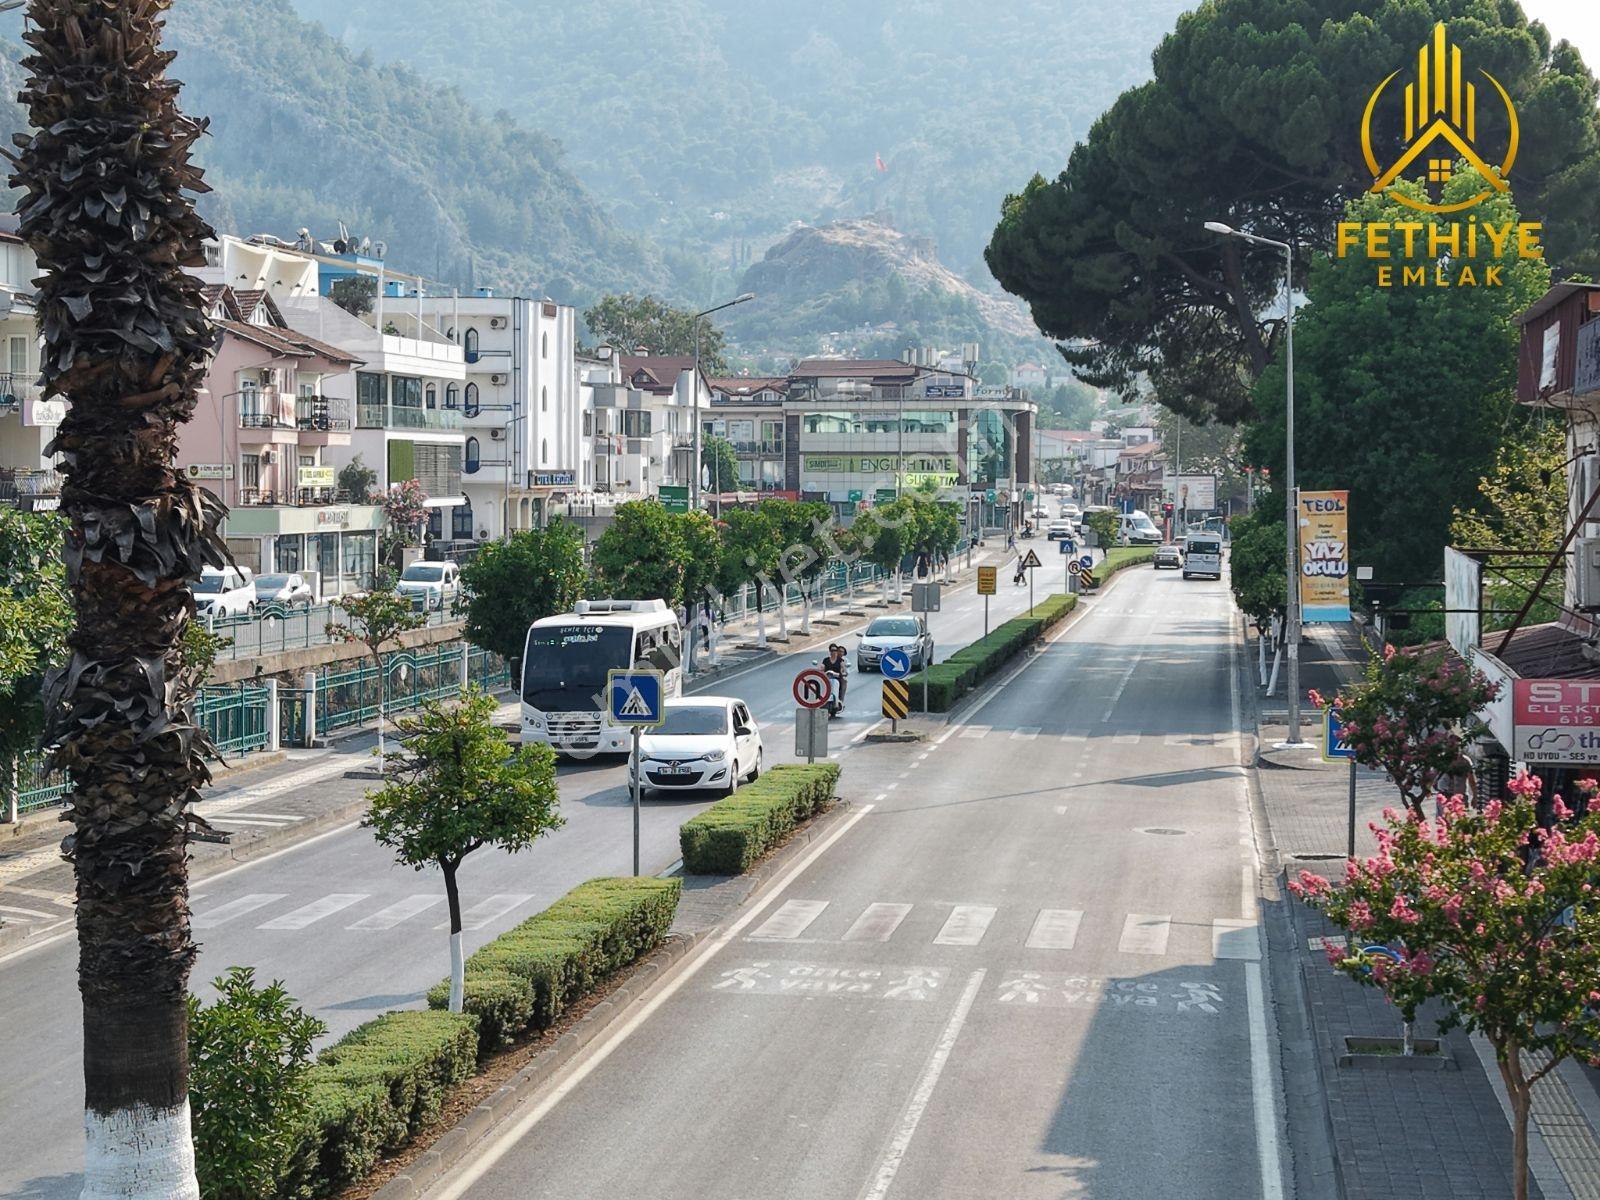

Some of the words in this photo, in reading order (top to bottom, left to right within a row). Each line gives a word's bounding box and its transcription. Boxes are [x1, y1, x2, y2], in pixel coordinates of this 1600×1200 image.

[861, 458, 916, 471] ENGLISH
[1302, 499, 1345, 512] TEOL
[1304, 541, 1345, 560] YAZ
[1303, 559, 1348, 578] OKULU
[1529, 682, 1600, 704] ST
[1560, 715, 1593, 725] 612
[1537, 752, 1560, 760] UYDU
[1569, 752, 1586, 760] SES
